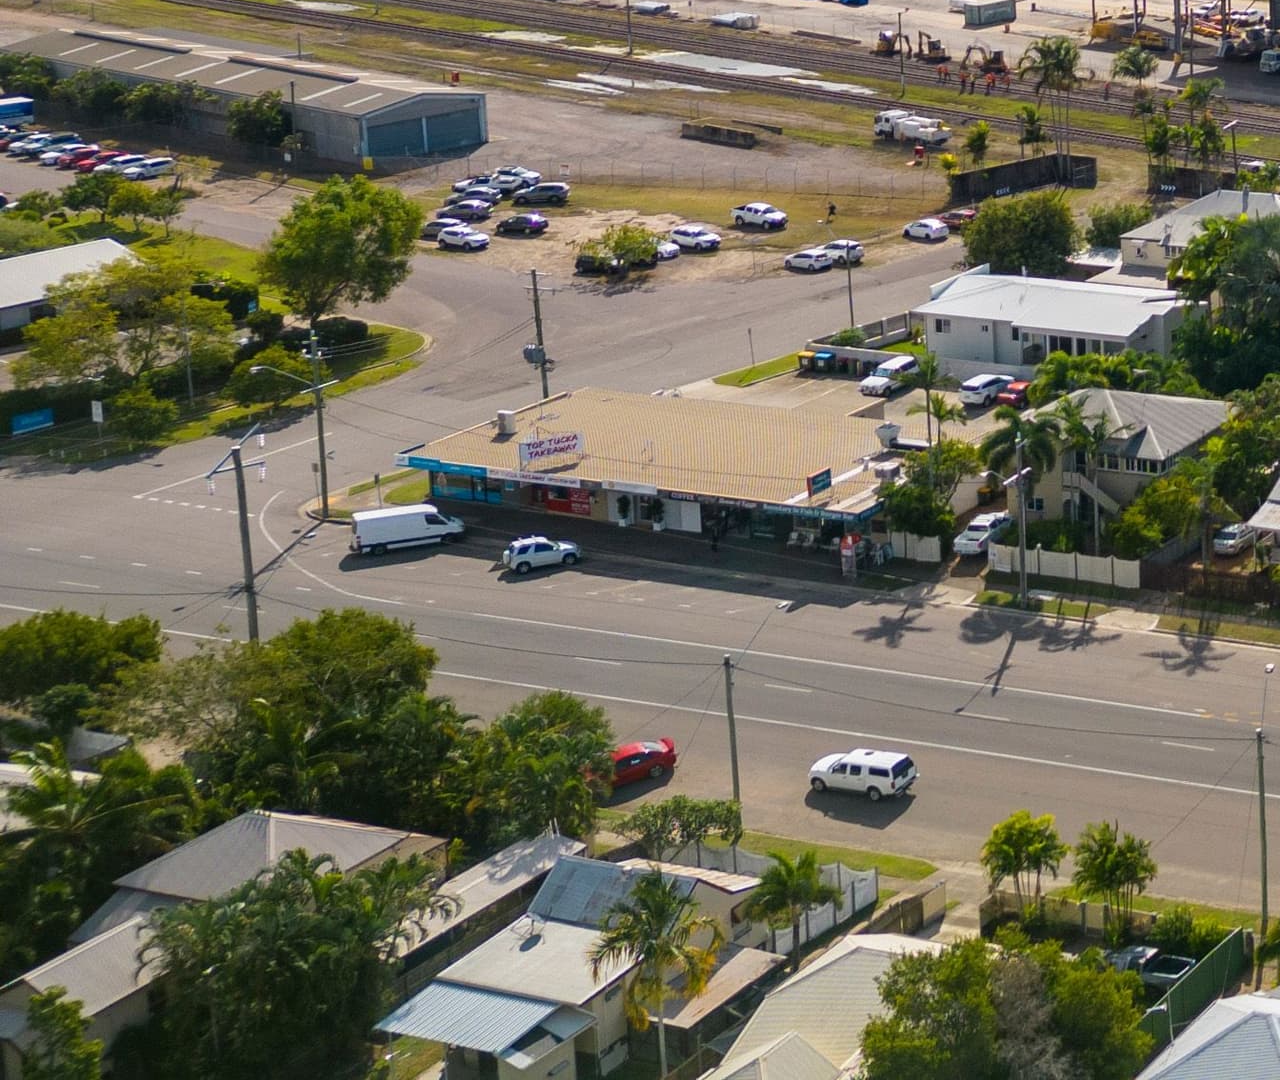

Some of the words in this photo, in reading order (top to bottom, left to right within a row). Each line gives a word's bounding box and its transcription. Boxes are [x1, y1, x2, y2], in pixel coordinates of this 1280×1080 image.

[526, 440, 545, 451] TOP
[547, 434, 578, 446] TUCKA
[527, 443, 577, 459] TAKEAWAY
